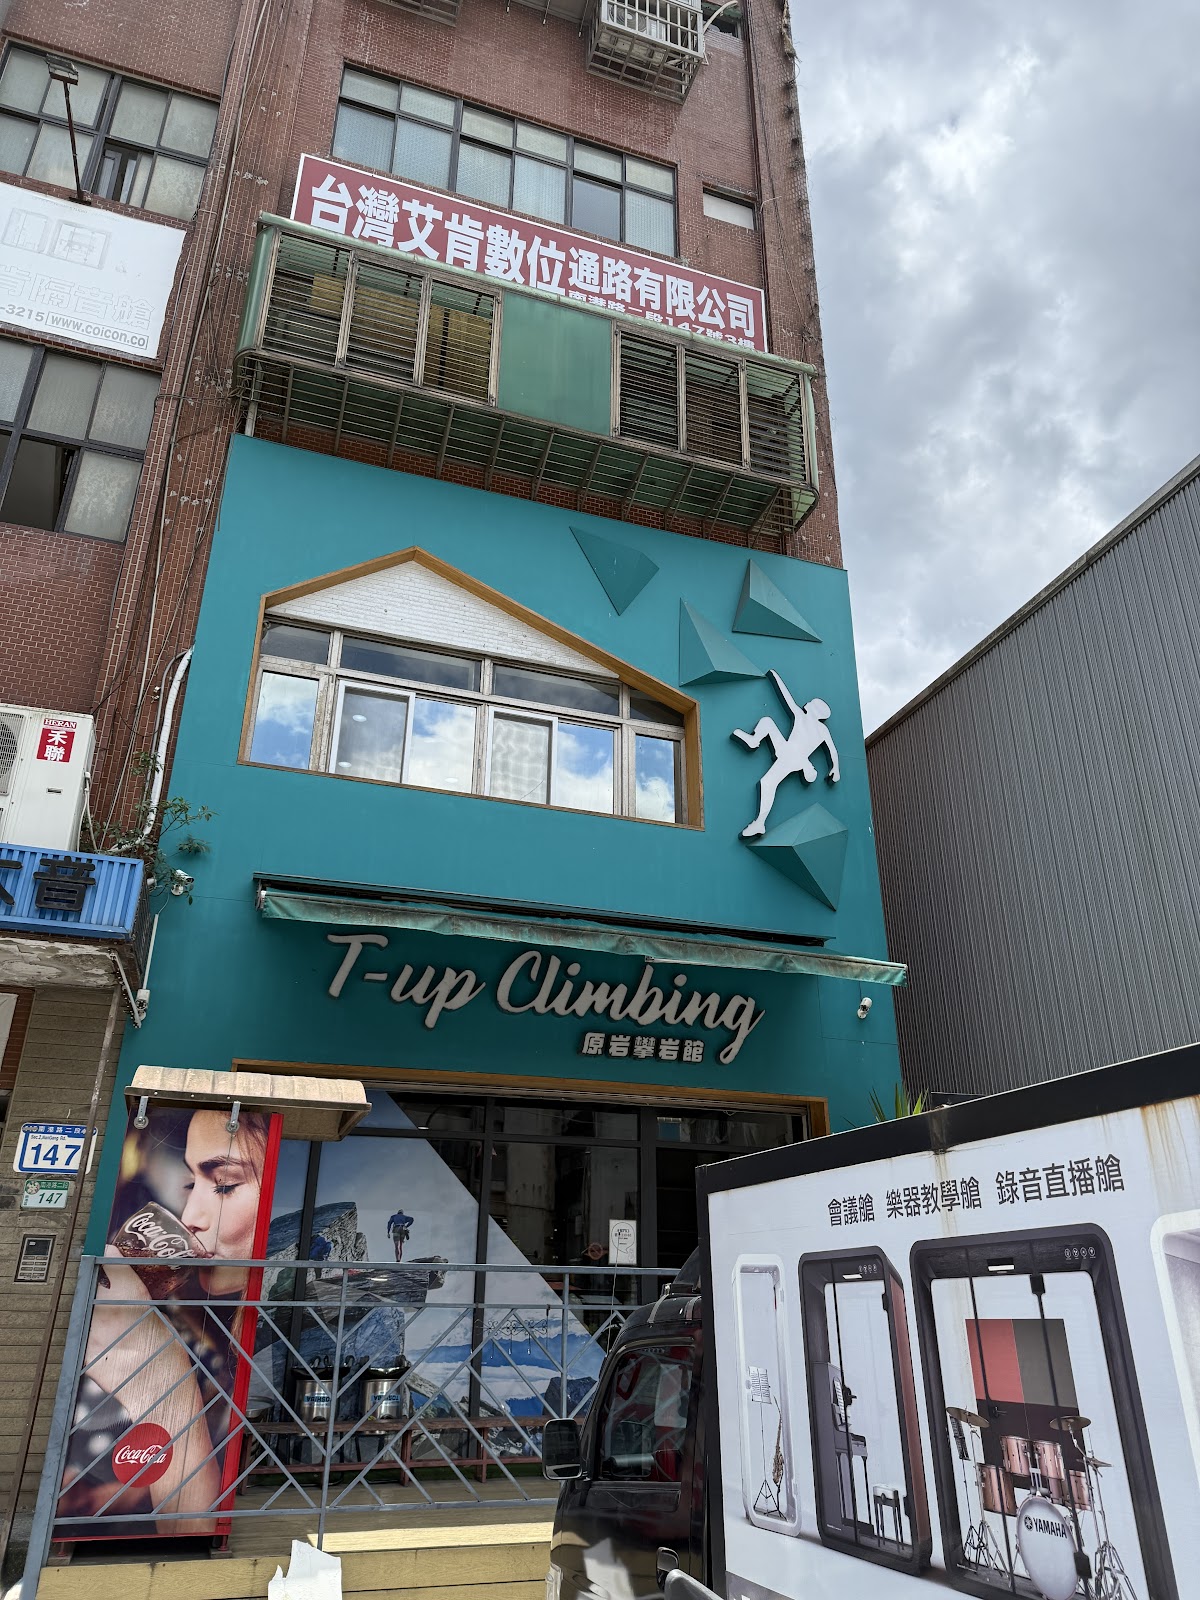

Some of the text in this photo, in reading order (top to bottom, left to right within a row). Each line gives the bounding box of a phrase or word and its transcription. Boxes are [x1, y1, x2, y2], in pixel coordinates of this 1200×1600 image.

[310, 173, 755, 338] 台灣艾肯數位通路有限公司
[51, 315, 146, 347] www.coicon.co
[44, 719, 77, 729] HERAN
[44, 730, 68, 761] 禾聯
[327, 934, 766, 1065] T-up Climbing
[581, 1032, 705, 1063] 原岩攀岩館
[31, 1143, 81, 1166] 147
[38, 1192, 63, 1204] 147
[827, 1153, 1125, 1227] 會議艙 樂器教學艙 錄音直播艙
[1033, 1517, 1068, 1539] YAMAHA
